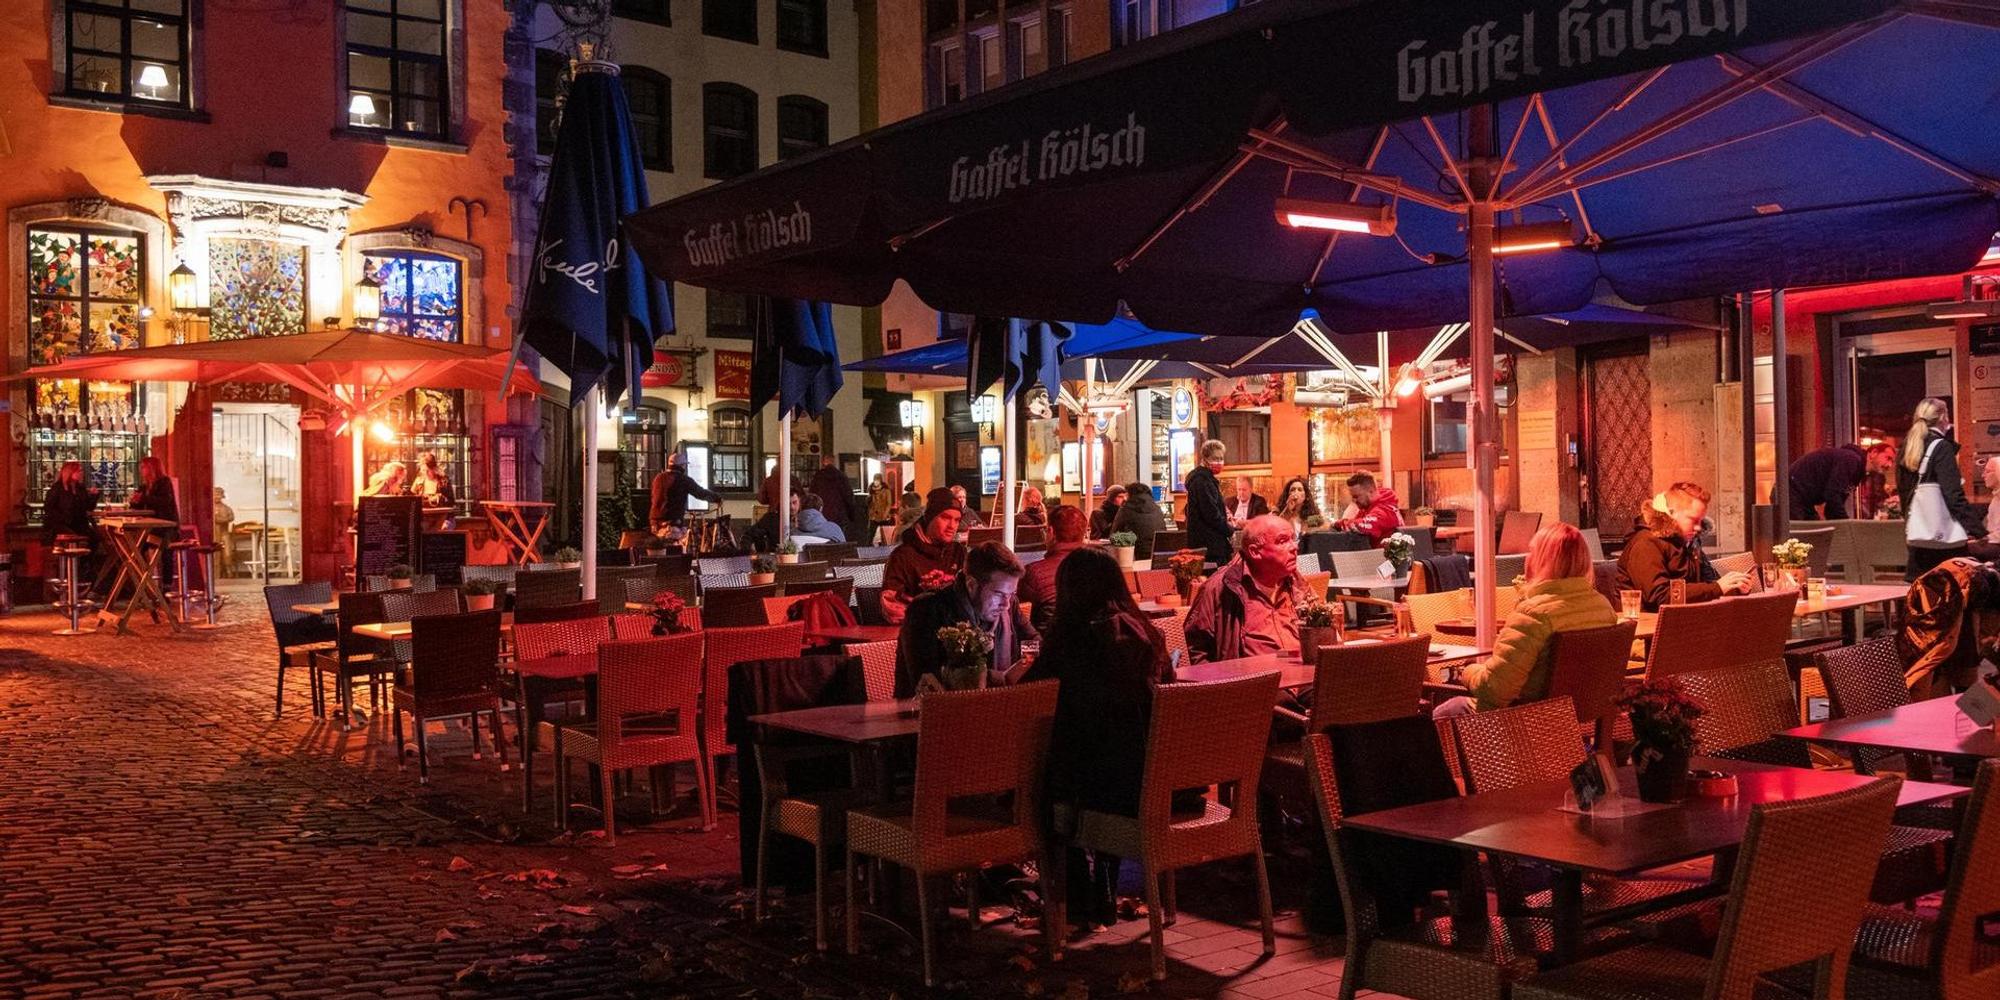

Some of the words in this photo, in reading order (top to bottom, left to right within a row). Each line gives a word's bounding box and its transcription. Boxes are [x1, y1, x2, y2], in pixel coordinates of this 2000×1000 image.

[1398, 10, 1541, 102] Gaffel
[949, 138, 1031, 203] Gaffel
[1038, 111, 1146, 181] Kölsch
[683, 220, 743, 267] Gaffel
[744, 200, 811, 254] Kölsch
